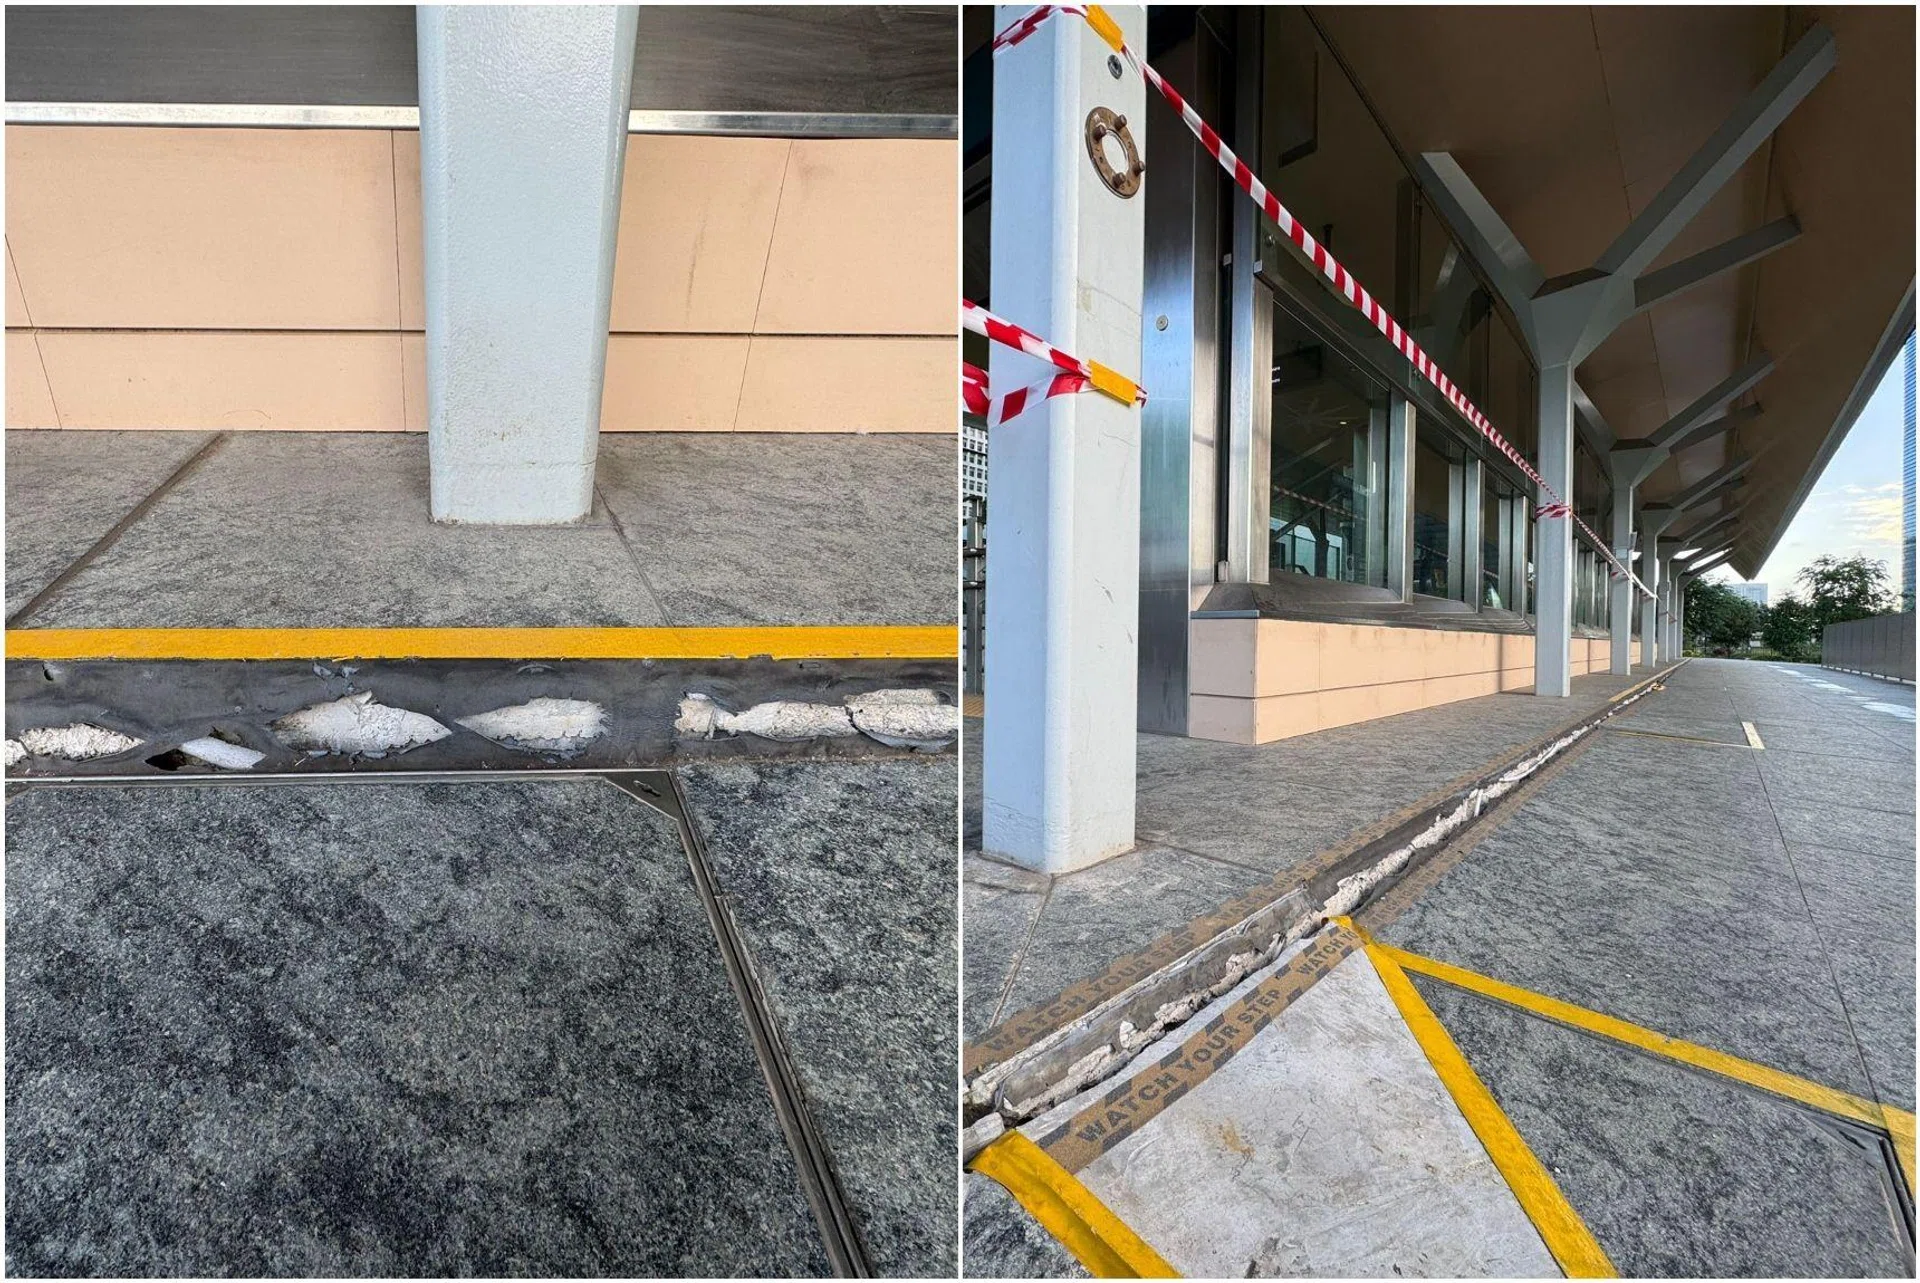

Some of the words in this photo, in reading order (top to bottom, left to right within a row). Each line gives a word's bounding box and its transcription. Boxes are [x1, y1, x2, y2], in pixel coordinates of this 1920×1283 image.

[986, 995, 1086, 1051] WATCH
[1085, 958, 1151, 993] YOUR
[1150, 931, 1195, 957] STEP
[1297, 936, 1344, 975] WATCH
[1076, 1072, 1178, 1142] WATCH
[1175, 1026, 1240, 1072] YOUR
[1237, 989, 1280, 1024] STEP
